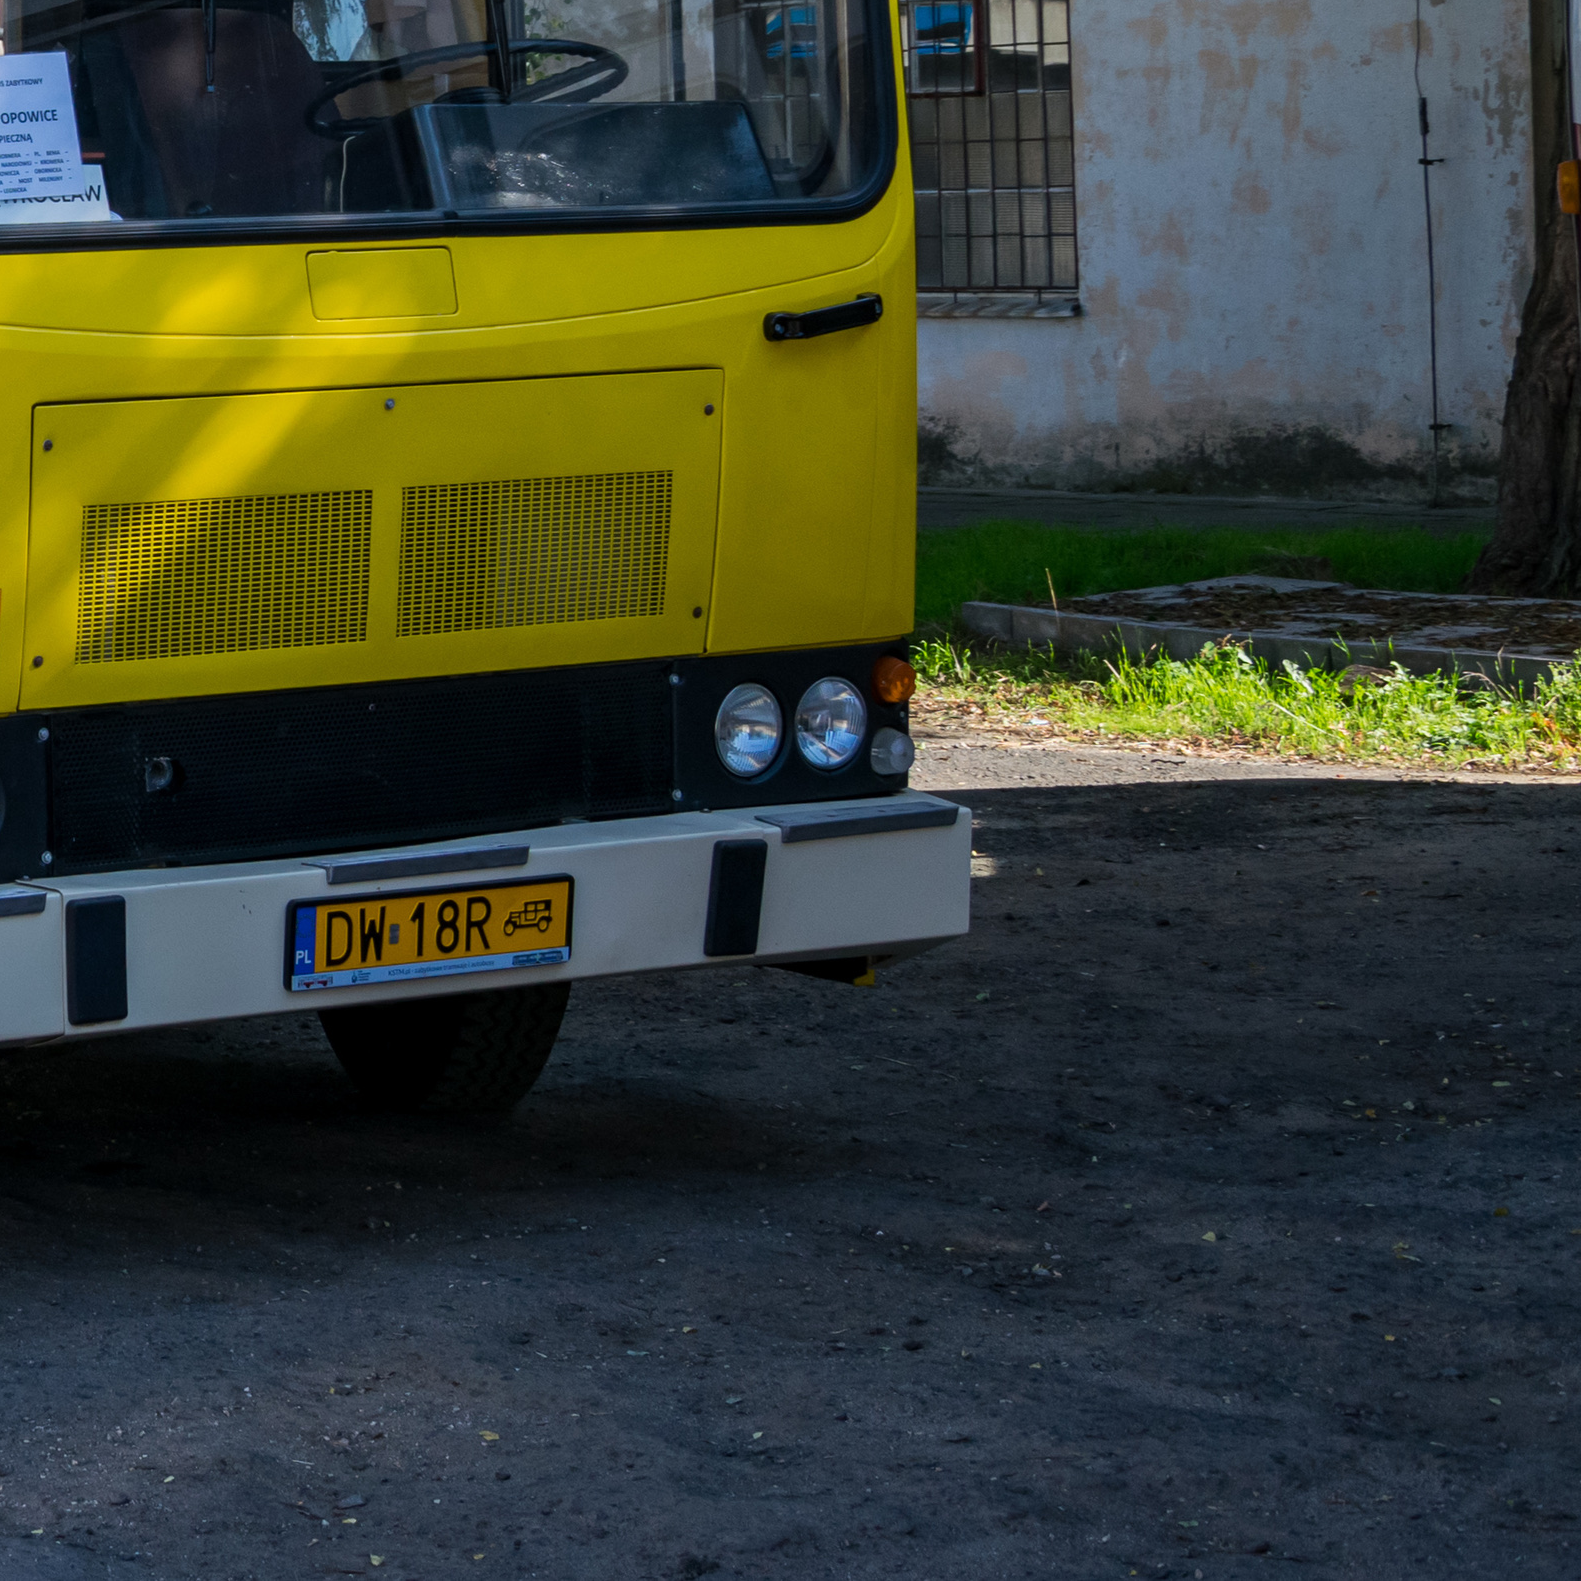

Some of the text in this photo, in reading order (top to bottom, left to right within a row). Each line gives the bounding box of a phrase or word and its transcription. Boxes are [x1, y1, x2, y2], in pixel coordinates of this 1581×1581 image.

[5, 78, 43, 87] ZABYTKOWY
[325, 896, 491, 967] DW 18R
[295, 950, 312, 964] PL
